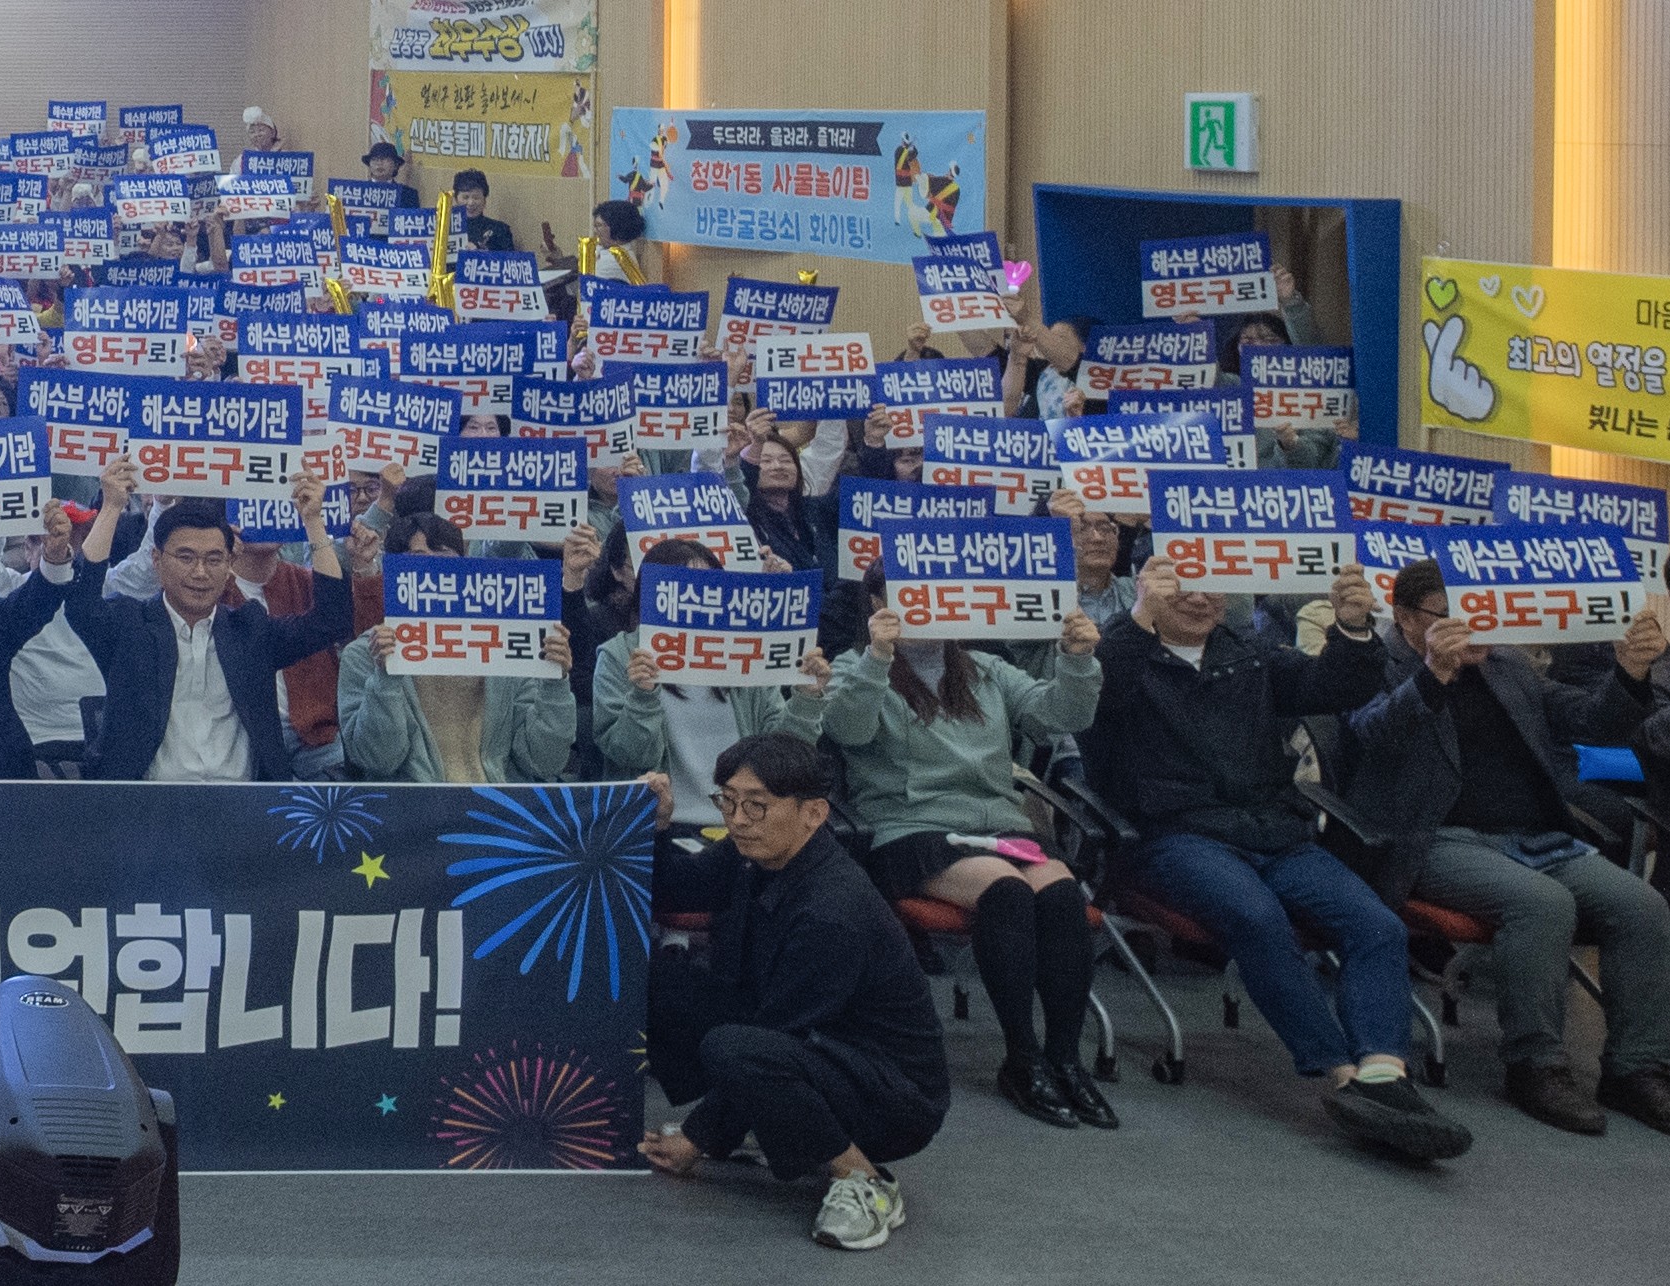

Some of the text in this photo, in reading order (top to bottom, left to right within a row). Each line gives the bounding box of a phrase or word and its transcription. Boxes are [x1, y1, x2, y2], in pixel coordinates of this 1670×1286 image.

[429, 14, 530, 62] 최우수상
[409, 118, 551, 162] 신선풍물패 지화자!
[817, 126, 856, 148] 즐겨라!
[691, 160, 870, 200] 청학1동 사물놀이팀
[19, 230, 58, 250] 산하기관
[696, 206, 872, 250] 바람굴렁쇠 화이팅!
[1151, 242, 1263, 277] 해수부 산하기관
[74, 295, 179, 330] 해수부 산하기관
[1150, 277, 1267, 309] 영도구로!
[72, 335, 177, 364] 영도구로!
[1507, 334, 1667, 395] 최고의 열정을
[142, 393, 288, 438] 해수부 산하기관
[1587, 404, 1659, 439] 빛나는
[137, 444, 287, 485] 영도구로!
[449, 449, 578, 487] 해수부 산하기관
[445, 494, 577, 529] 영도구로!
[1166, 484, 1334, 528] 해수부 산하기관
[894, 530, 1056, 575] 해수부 산하기관
[1167, 538, 1343, 579] 영도구로!
[1448, 536, 1619, 580] 해수부 산하기관
[397, 571, 546, 614] 해수부 산하기관
[654, 580, 810, 627] 해수부 산하기관
[896, 584, 1062, 625] 영도구로!
[1459, 590, 1637, 631] 영도구로!
[394, 622, 547, 662] 영도구로!
[649, 633, 806, 671] 영도구로!
